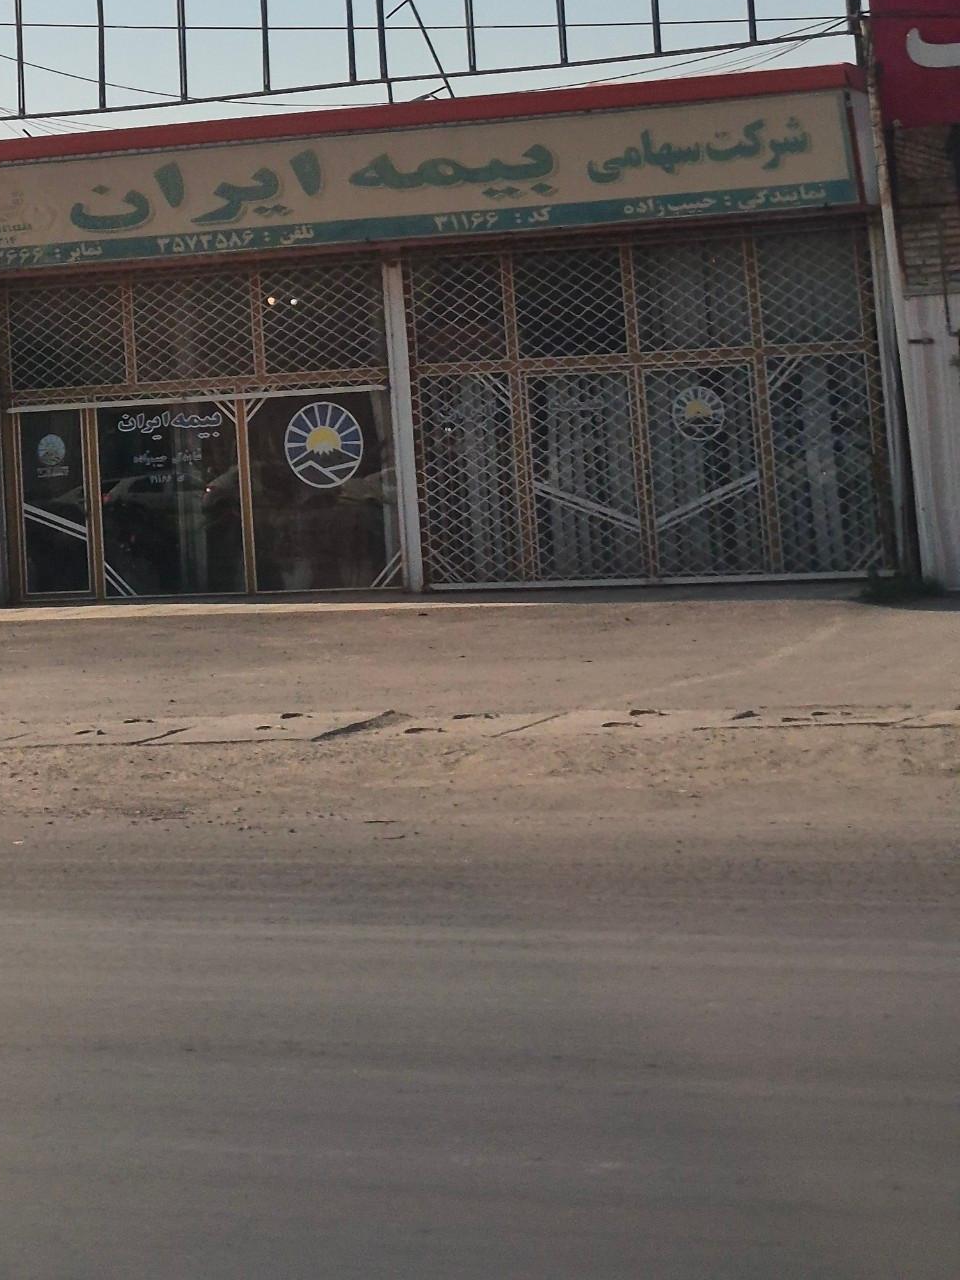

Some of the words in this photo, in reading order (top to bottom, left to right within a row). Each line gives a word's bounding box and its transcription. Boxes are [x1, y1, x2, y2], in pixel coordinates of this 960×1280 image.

[586, 129, 703, 184] سهامی
[704, 117, 810, 171] شرکت
[348, 142, 556, 200] بیمه
[70, 148, 326, 231] ایران
[737, 183, 828, 211] نمایندگی
[279, 224, 315, 245] تلفن
[432, 211, 499, 233] ۳۱۱۶۶
[69, 241, 105, 265] نمابر
[117, 410, 171, 441] ایران
[170, 411, 223, 439] بیمه
